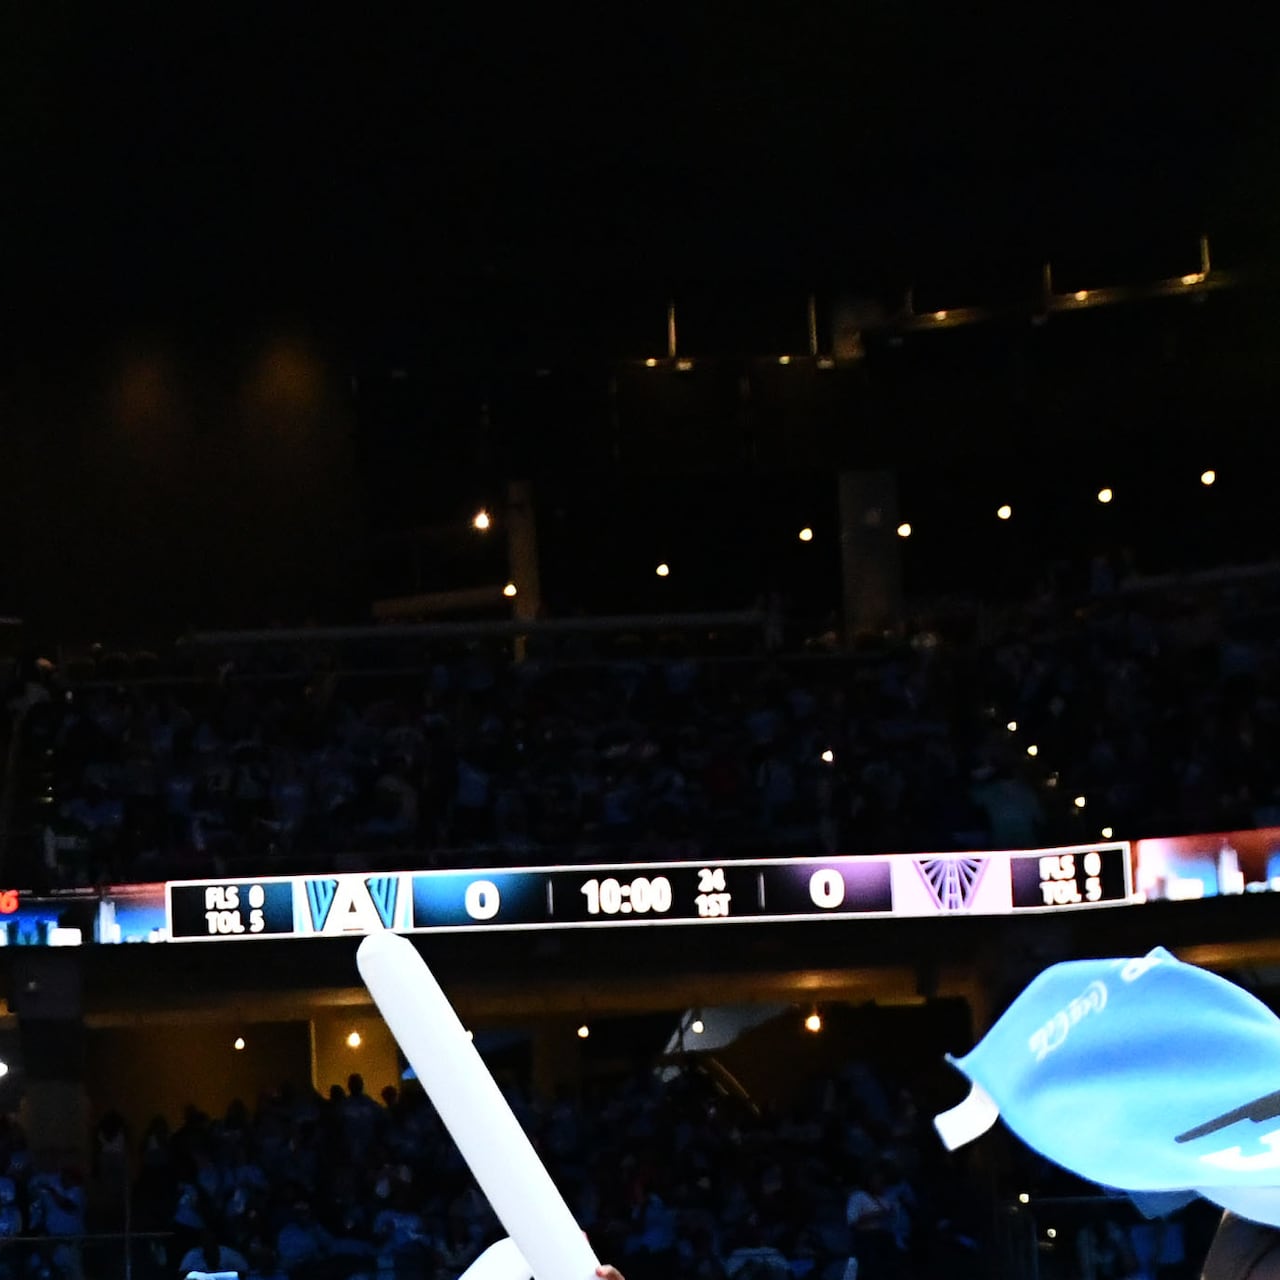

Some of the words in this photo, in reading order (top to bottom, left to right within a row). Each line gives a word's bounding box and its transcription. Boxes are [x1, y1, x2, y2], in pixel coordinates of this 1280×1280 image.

[1039, 854, 1076, 881] FLS
[1083, 852, 1101, 877] 0
[205, 886, 239, 911] FLS
[248, 884, 265, 909] 0
[464, 880, 501, 920] 0
[580, 876, 673, 915] 10:00
[809, 868, 845, 909] 0
[1039, 878, 1082, 905] TOL
[1085, 877, 1102, 902] 5
[694, 892, 732, 918] 1ST
[205, 910, 245, 935] TOL
[249, 909, 265, 934] 5
